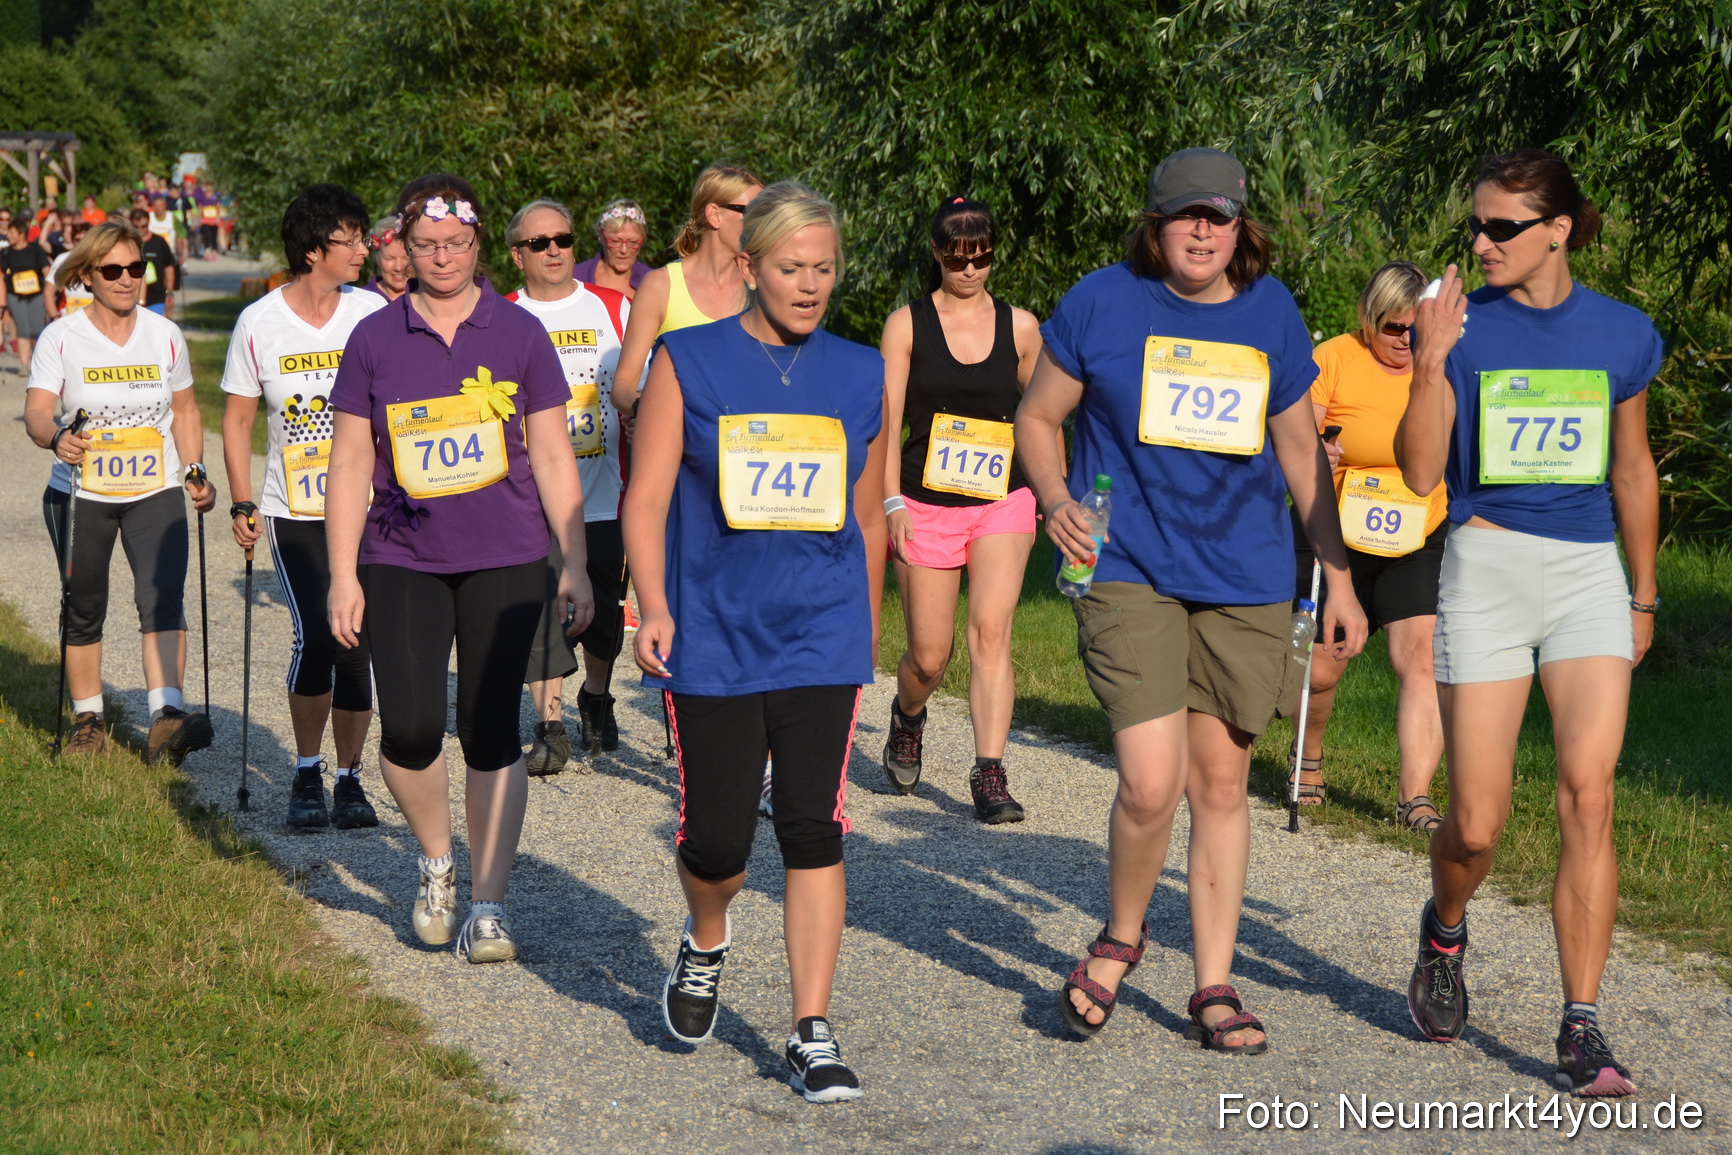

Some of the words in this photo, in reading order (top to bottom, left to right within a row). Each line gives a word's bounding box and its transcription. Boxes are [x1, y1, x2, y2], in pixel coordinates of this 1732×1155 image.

[555, 331, 590, 345] INE
[559, 346, 598, 355] Germany
[87, 367, 154, 381] ONLINE
[1501, 388, 1546, 398] firmenlauf
[1168, 382, 1241, 423] 792
[405, 414, 444, 426] firmenlauf
[1174, 425, 1198, 434] Nicola
[1507, 417, 1582, 452] 775
[740, 433, 785, 442] firmenlauf
[414, 433, 484, 471] 704
[92, 455, 157, 477] 1012
[937, 446, 1004, 478] 1176
[428, 475, 457, 484] Manuela
[457, 471, 479, 479] Kohler
[747, 461, 821, 498] 747
[739, 504, 759, 512] Erika
[760, 505, 825, 514] Kordon-Hoffmann
[1365, 506, 1402, 535] 69
[1375, 537, 1400, 546] Schubert
